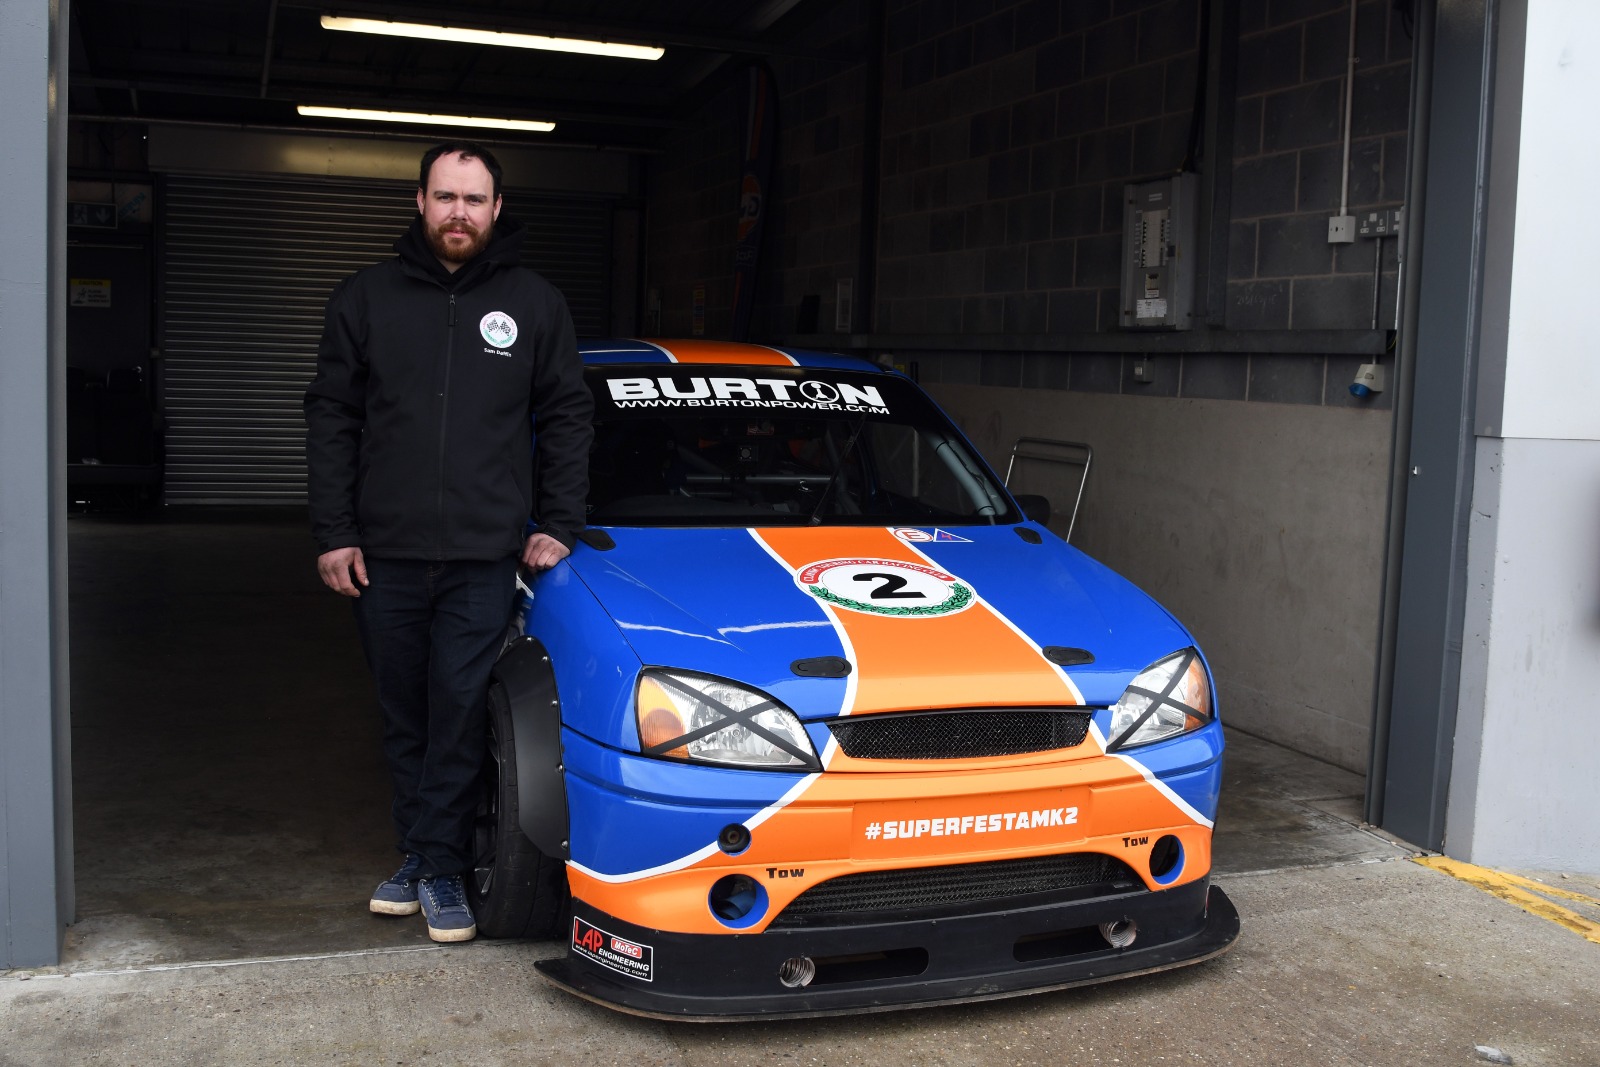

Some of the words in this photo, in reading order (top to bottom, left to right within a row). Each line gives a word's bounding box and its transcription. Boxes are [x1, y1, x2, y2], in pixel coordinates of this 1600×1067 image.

[606, 377, 886, 407] BURTON
[853, 572, 927, 599] 2
[864, 806, 1079, 840] #SUPERFESTAMK2
[574, 919, 604, 953] LAP
[598, 948, 650, 972] ENGINEERING
[614, 941, 639, 956] MoTeC
